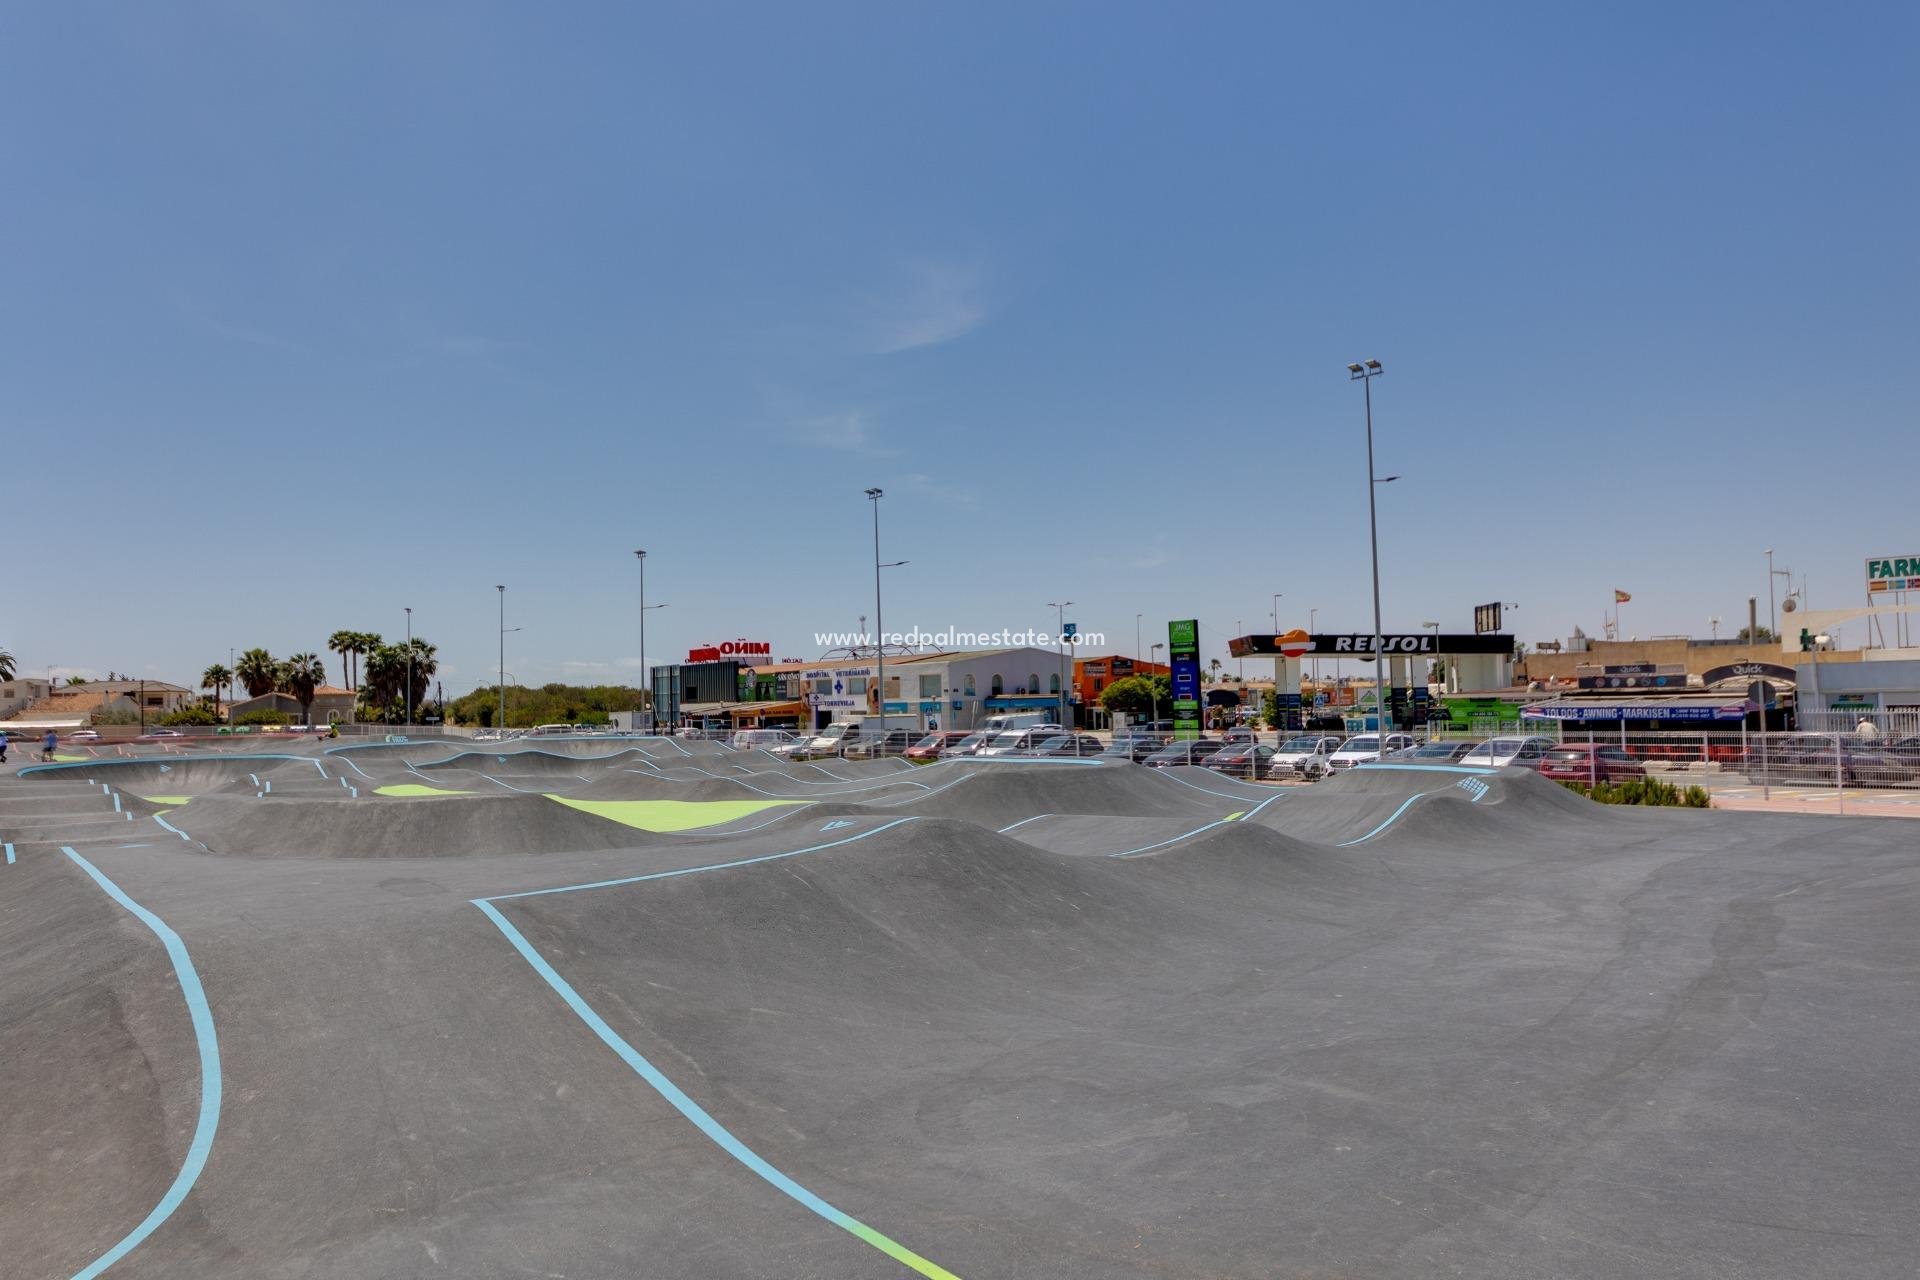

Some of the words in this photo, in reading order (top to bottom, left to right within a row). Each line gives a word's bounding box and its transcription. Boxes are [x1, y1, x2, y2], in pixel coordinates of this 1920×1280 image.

[1869, 558, 1920, 579] FARM
[1335, 636, 1432, 651] REPSOL
[1732, 664, 1762, 674] Quick
[1545, 708, 1578, 719] TOLDOS
[1583, 708, 1618, 719] AWNING
[1622, 708, 1670, 719] MARKISEN
